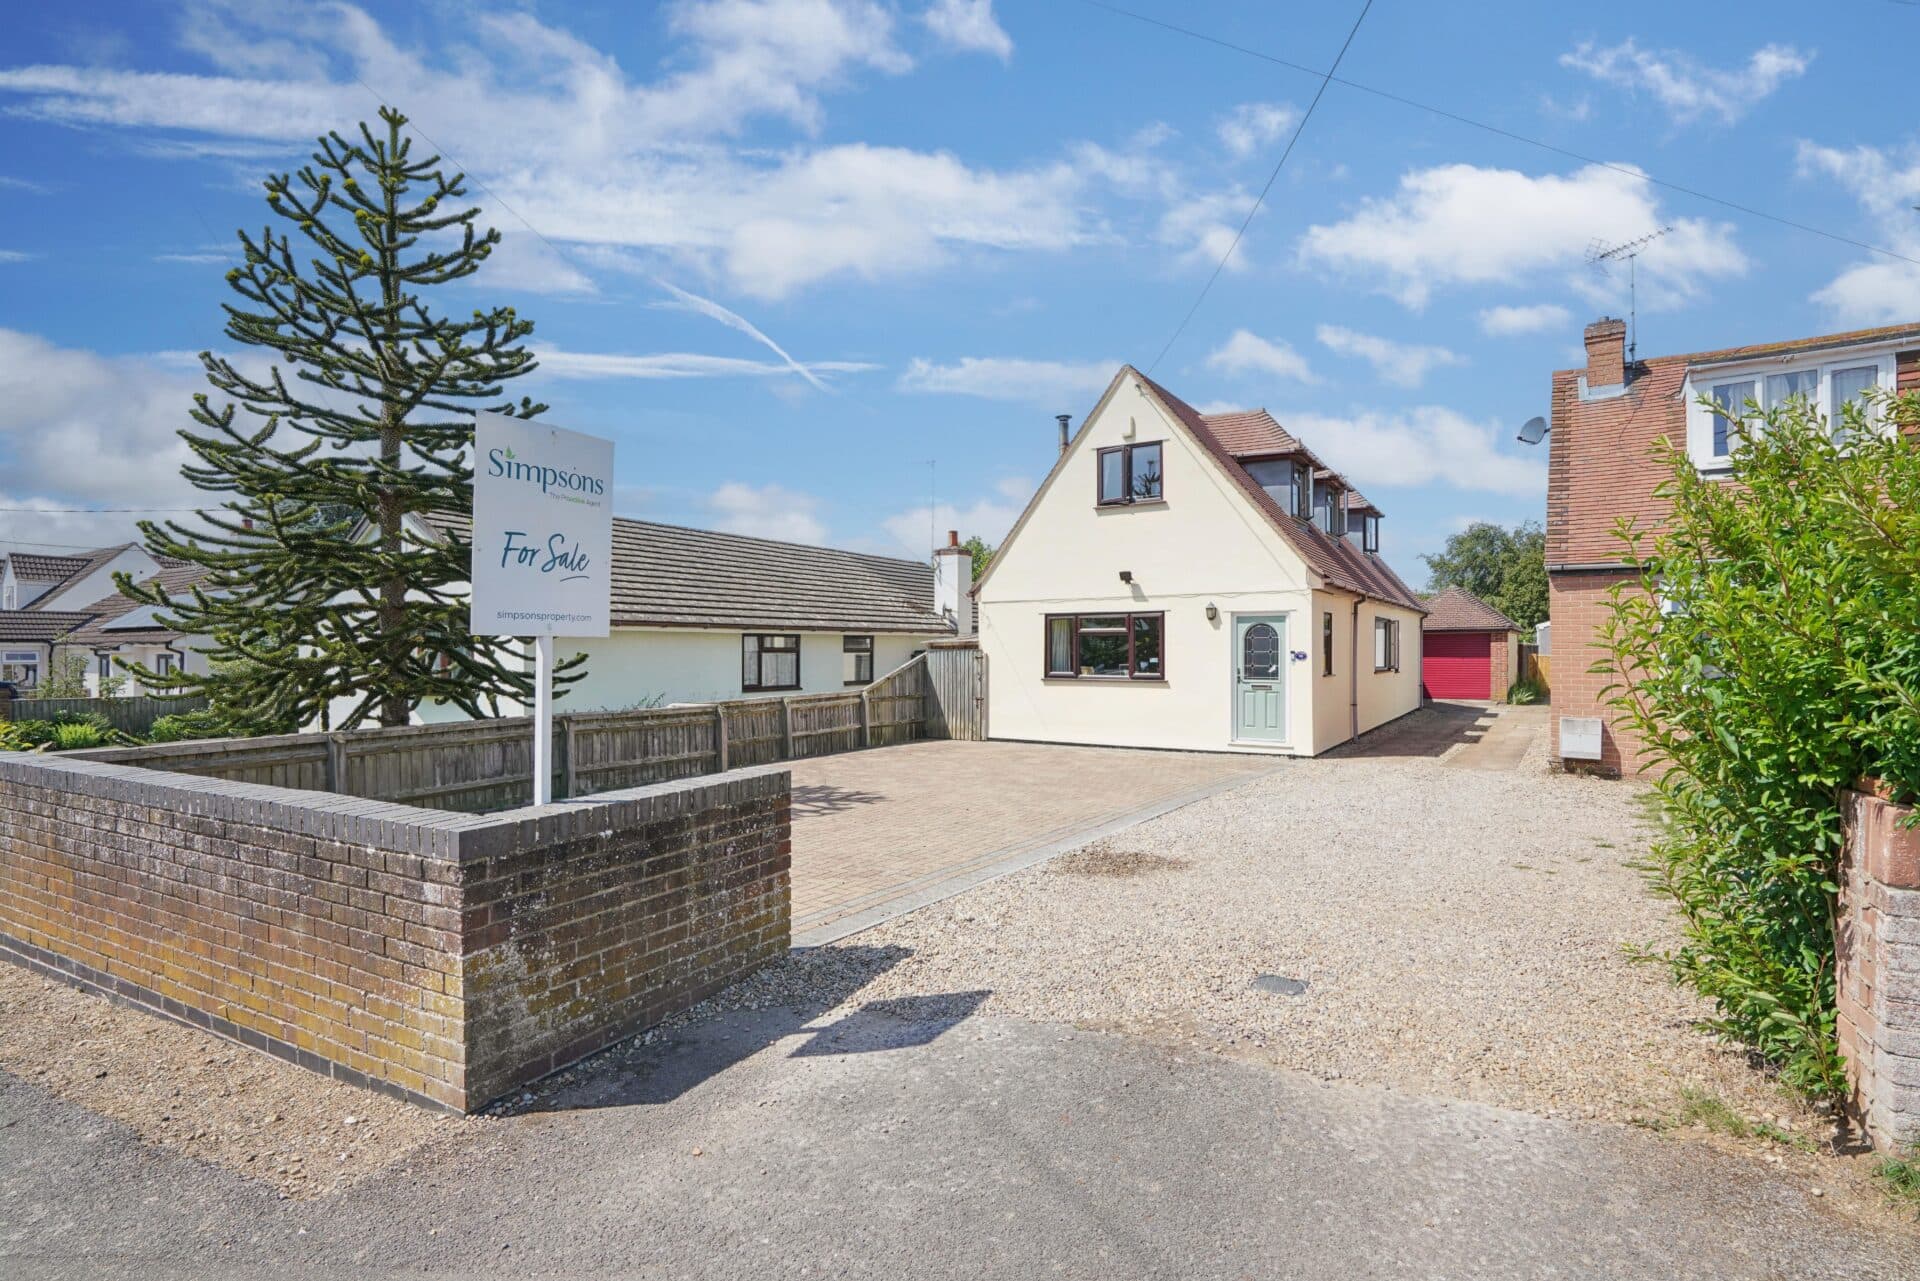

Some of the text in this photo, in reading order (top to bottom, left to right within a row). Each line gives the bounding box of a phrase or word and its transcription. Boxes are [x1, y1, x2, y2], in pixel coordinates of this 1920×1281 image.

[488, 446, 604, 495] Simpsons
[502, 531, 590, 573] For Sale
[496, 610, 592, 622] simpsonsproperty.com
